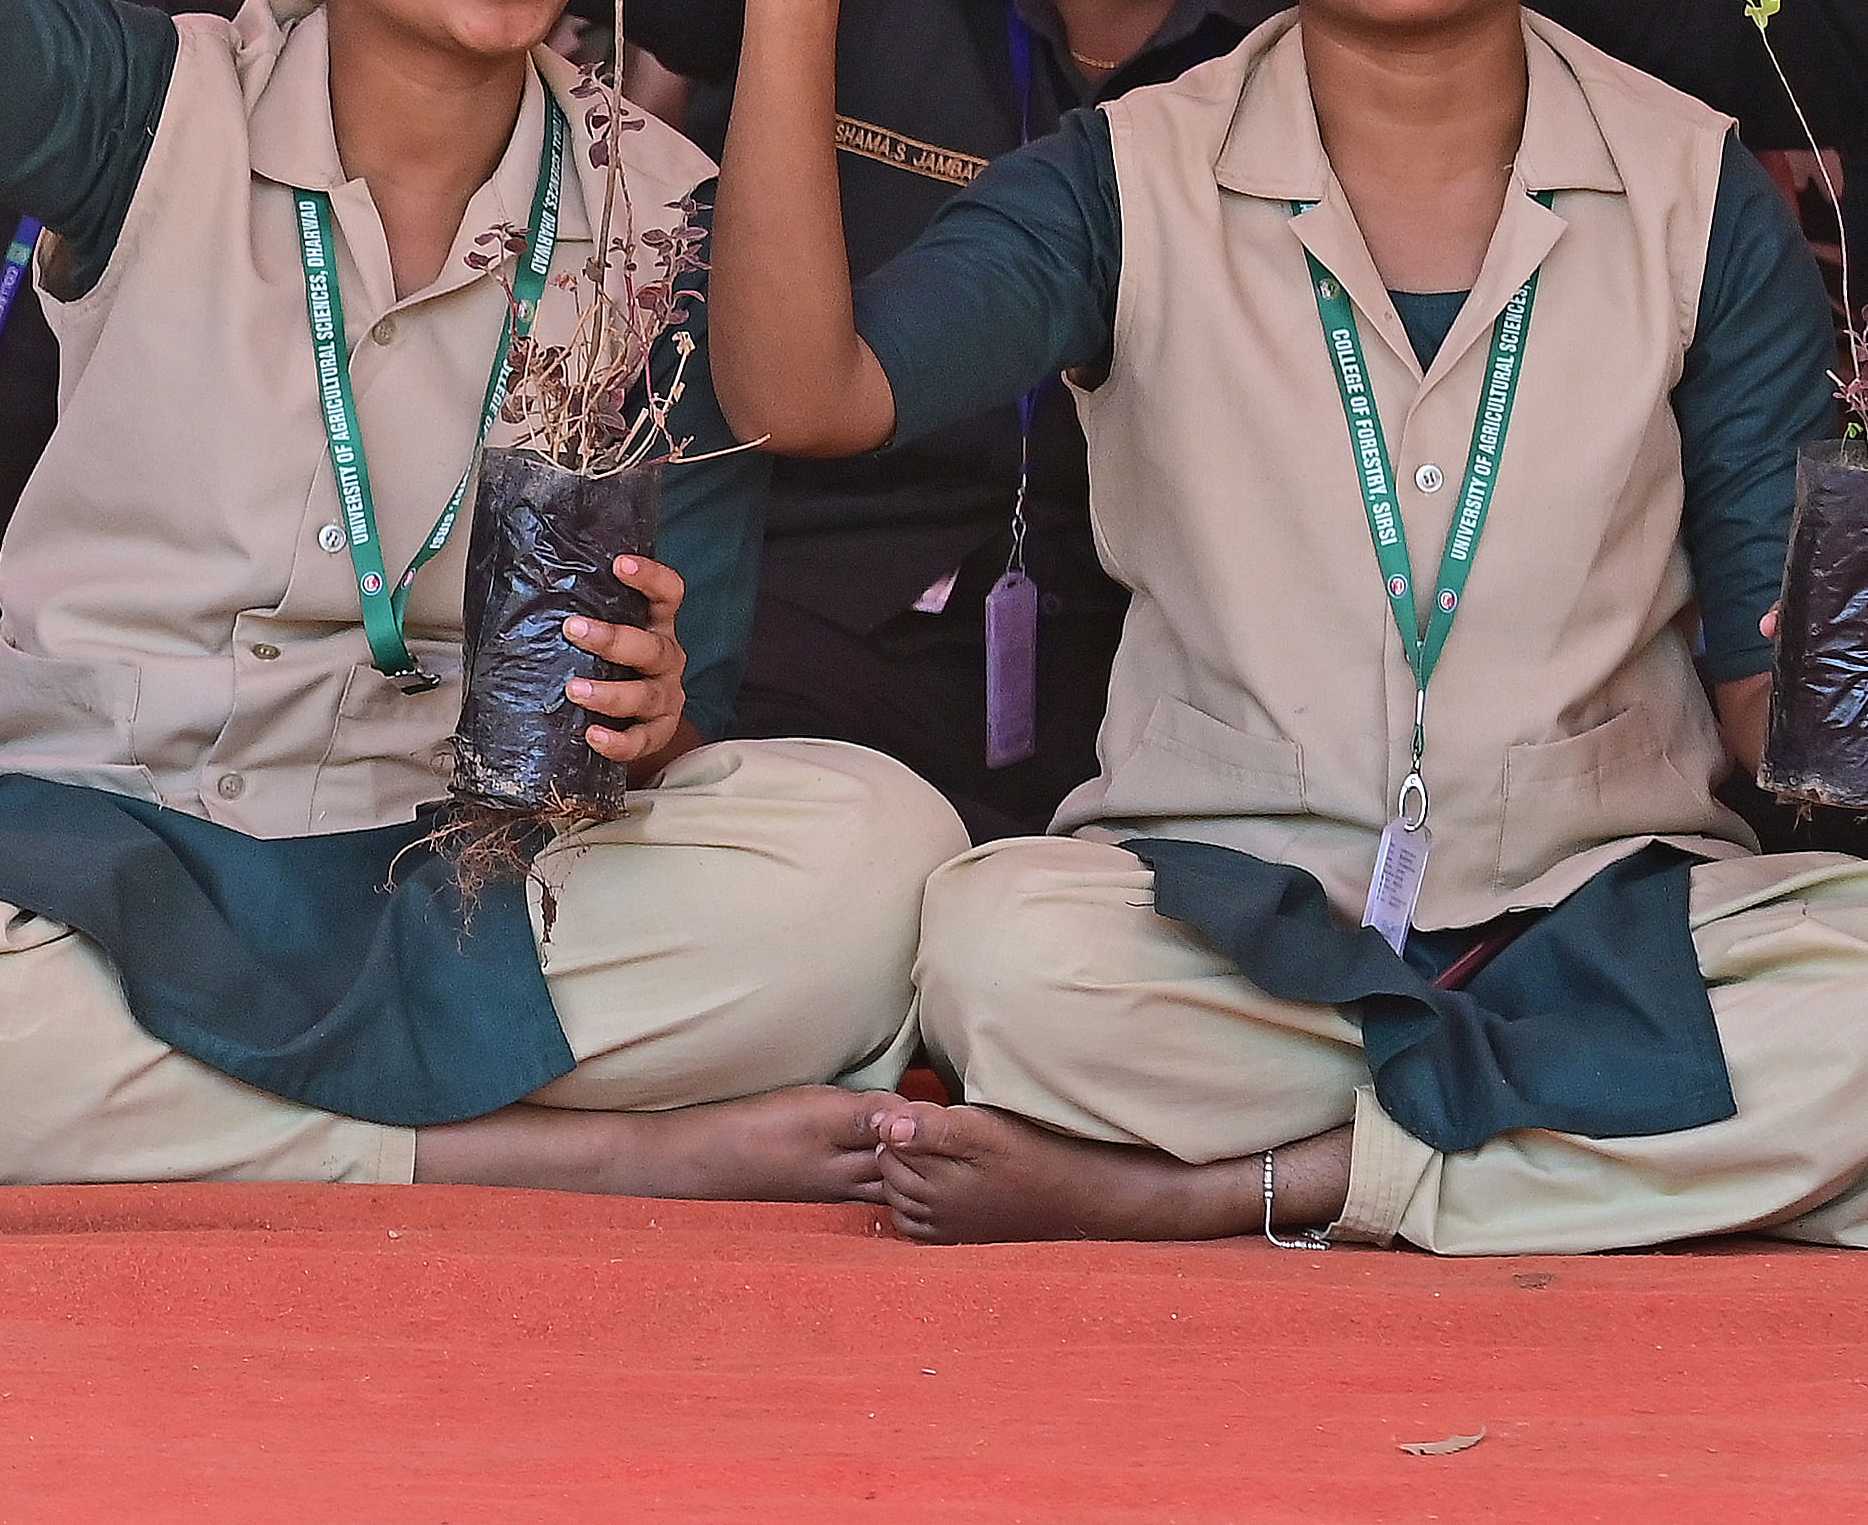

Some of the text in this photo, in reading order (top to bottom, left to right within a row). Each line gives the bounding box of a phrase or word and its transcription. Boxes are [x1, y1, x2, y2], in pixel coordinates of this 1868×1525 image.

[529, 208, 558, 276] DHARWAD
[298, 200, 371, 547] UNIVERSITY OF AGRICULTURAL SCIENCES, DHARWAD
[1477, 357, 1516, 456] AGRICULTURAL
[1331, 327, 1398, 547] COLLEGE OF FORESTRY, SIRSI
[1474, 454, 1493, 477] OF
[1450, 475, 1489, 562] UNIVERSITY
